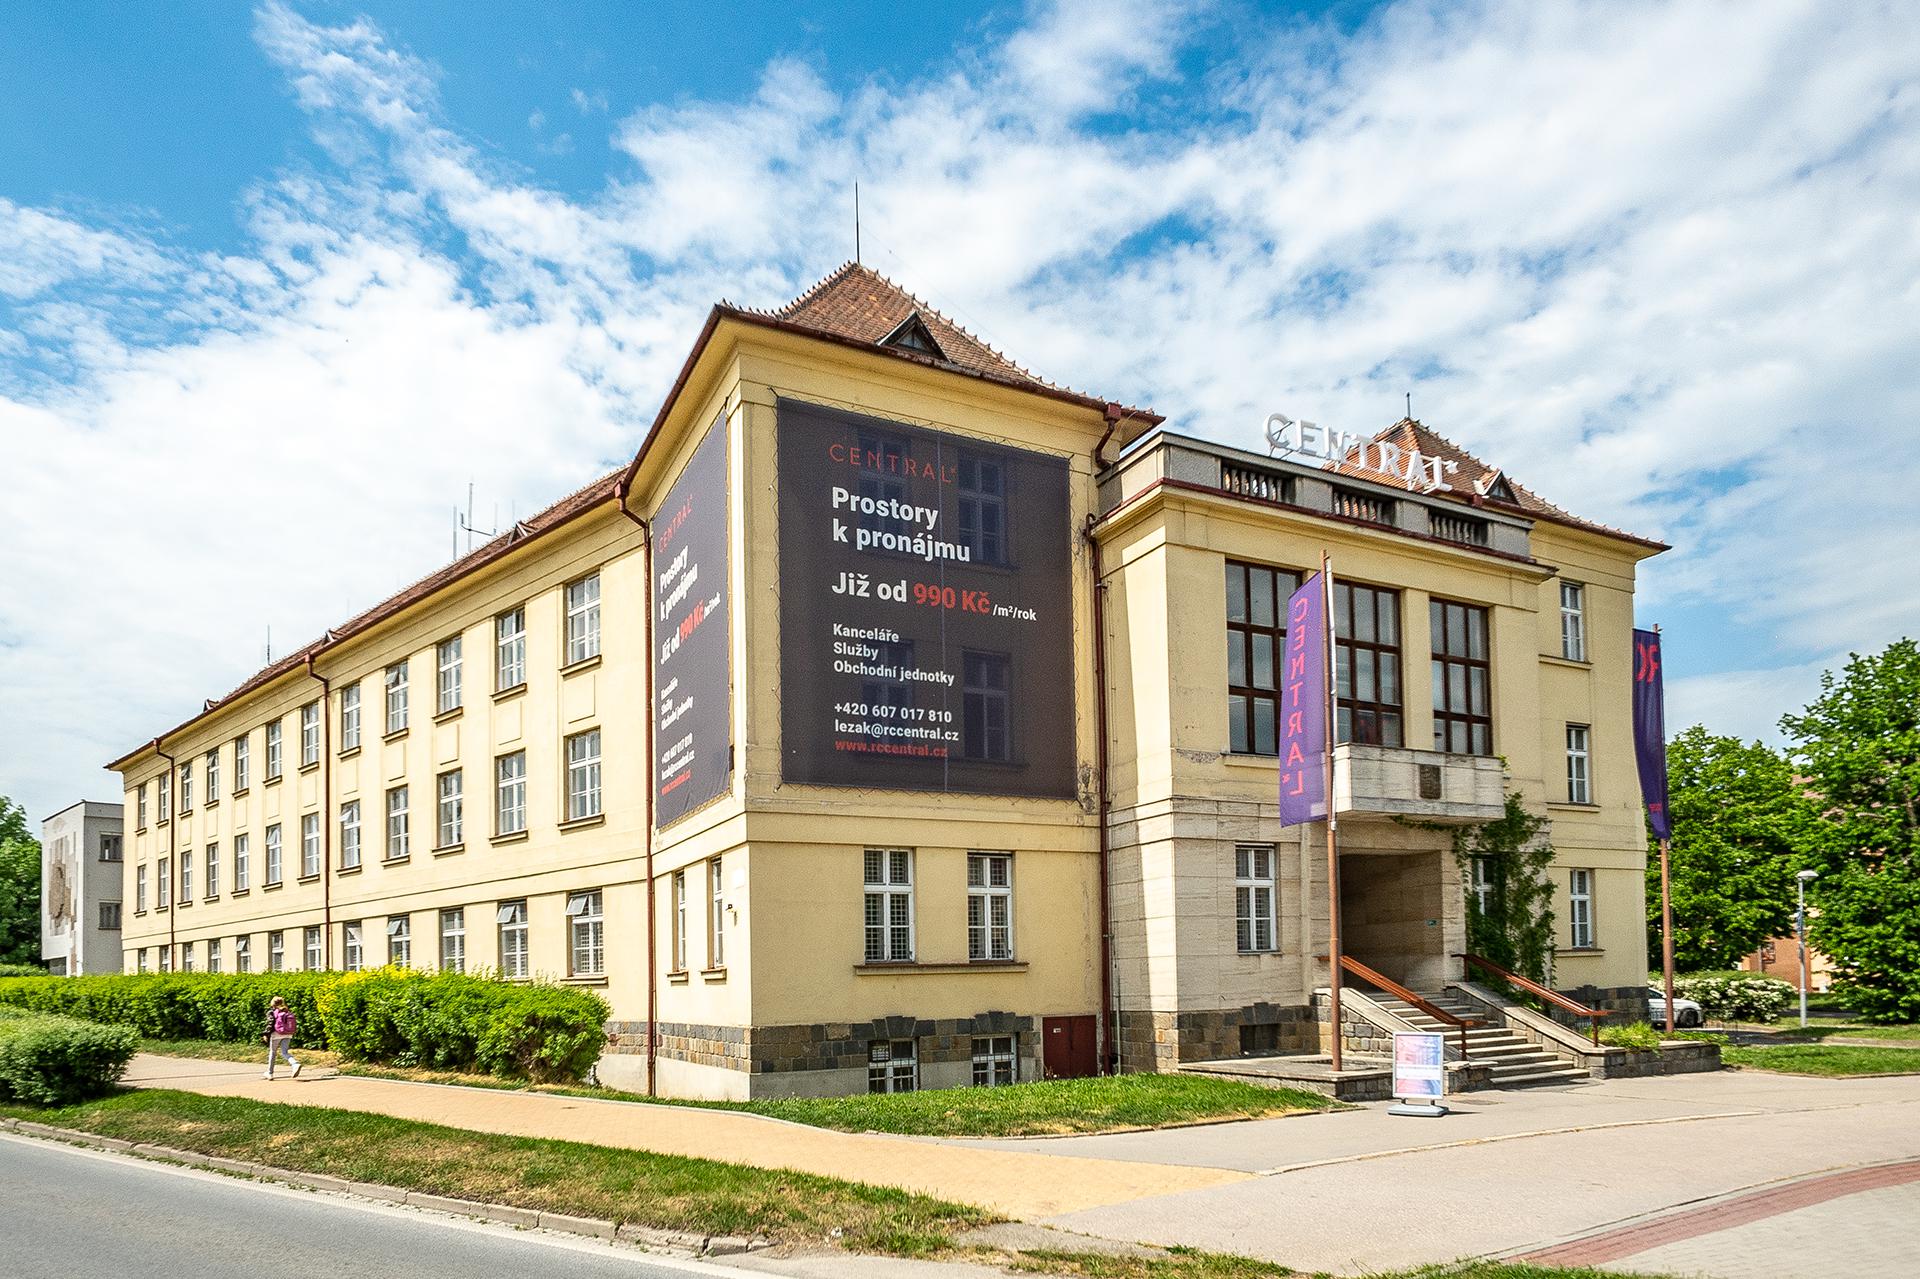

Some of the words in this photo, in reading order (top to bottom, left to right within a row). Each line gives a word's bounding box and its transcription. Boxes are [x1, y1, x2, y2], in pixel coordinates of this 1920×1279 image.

[828, 443, 953, 484] CENTRAL
[1263, 412, 1453, 493] CENTRAL
[831, 486, 939, 531] Prostory
[832, 518, 848, 543] k
[856, 528, 971, 562] pronájmu
[831, 572, 870, 598] Již
[877, 580, 908, 603] od
[913, 583, 956, 609] 990
[961, 589, 991, 615] Kč
[833, 623, 900, 643] Kanceláře
[833, 641, 879, 661] Služby
[833, 660, 897, 678] Obchodní
[899, 667, 955, 687] jednotky
[834, 702, 868, 716] +420
[871, 704, 897, 718] 607
[900, 707, 925, 721] 017
[928, 710, 953, 723] 810
[834, 719, 960, 741] lezak@rccentral.cz
[834, 740, 949, 758] www.rccentral.cz
